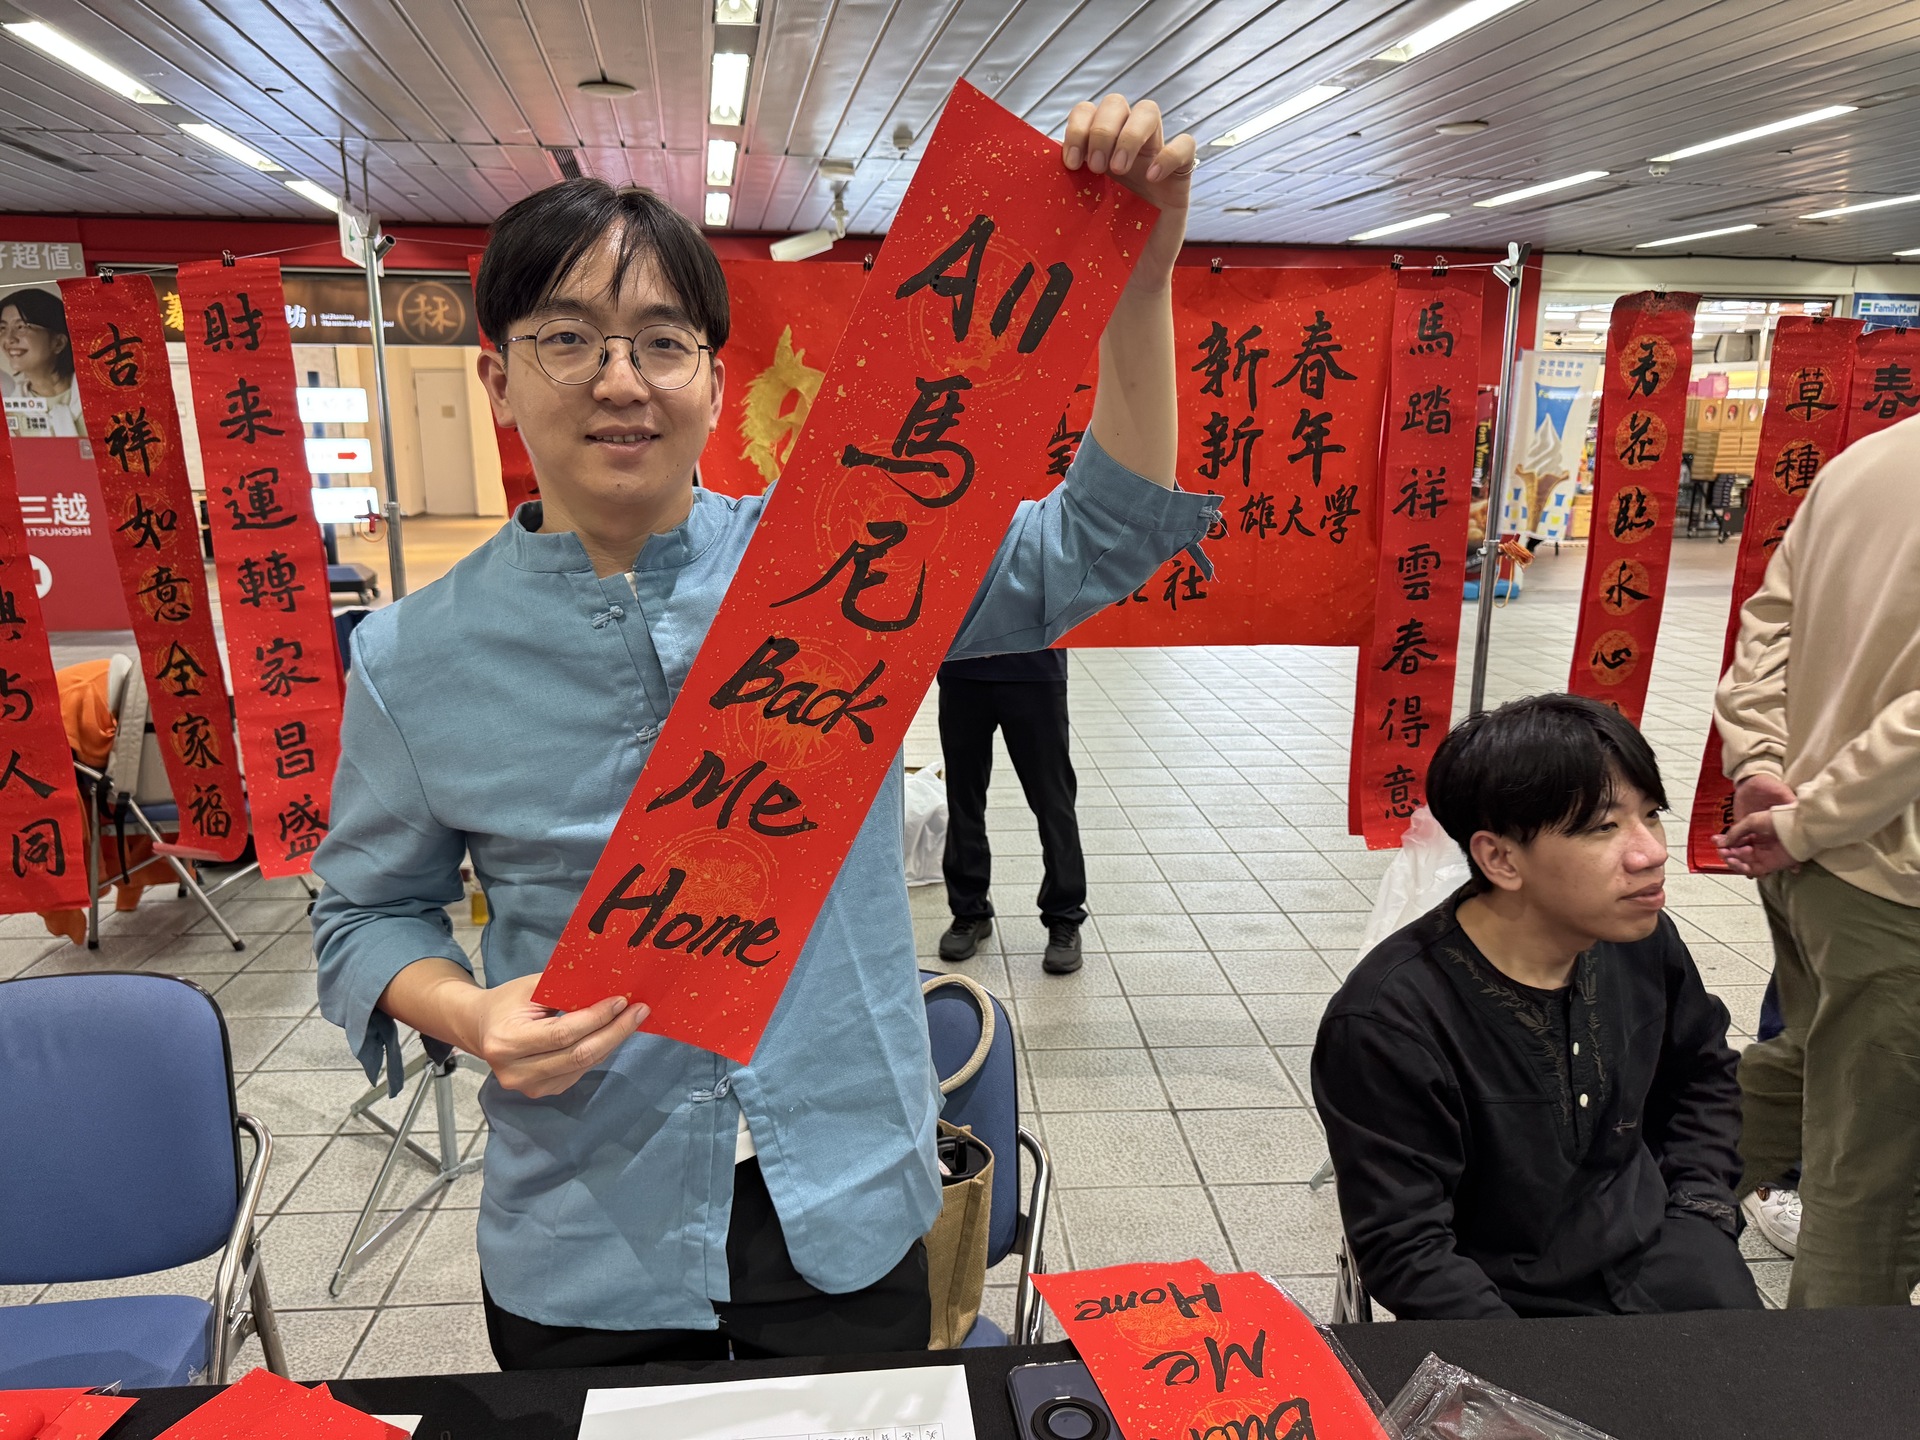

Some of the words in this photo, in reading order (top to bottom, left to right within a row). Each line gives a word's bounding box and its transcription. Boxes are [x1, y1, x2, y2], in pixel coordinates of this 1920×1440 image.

[896, 214, 1074, 354] All
[1874, 303, 1917, 314] FamilyMart
[19, 492, 90, 525] 三越
[26, 527, 91, 536] ITSUKOSHI
[88, 323, 232, 839] 吉祥如意全家福
[1379, 302, 1454, 820] 馬踏祥雲春得意
[708, 635, 888, 744] Back
[645, 750, 818, 836] Me
[587, 863, 782, 968] Home
[1073, 1281, 1223, 1321] Home
[1141, 1328, 1266, 1393] Me
